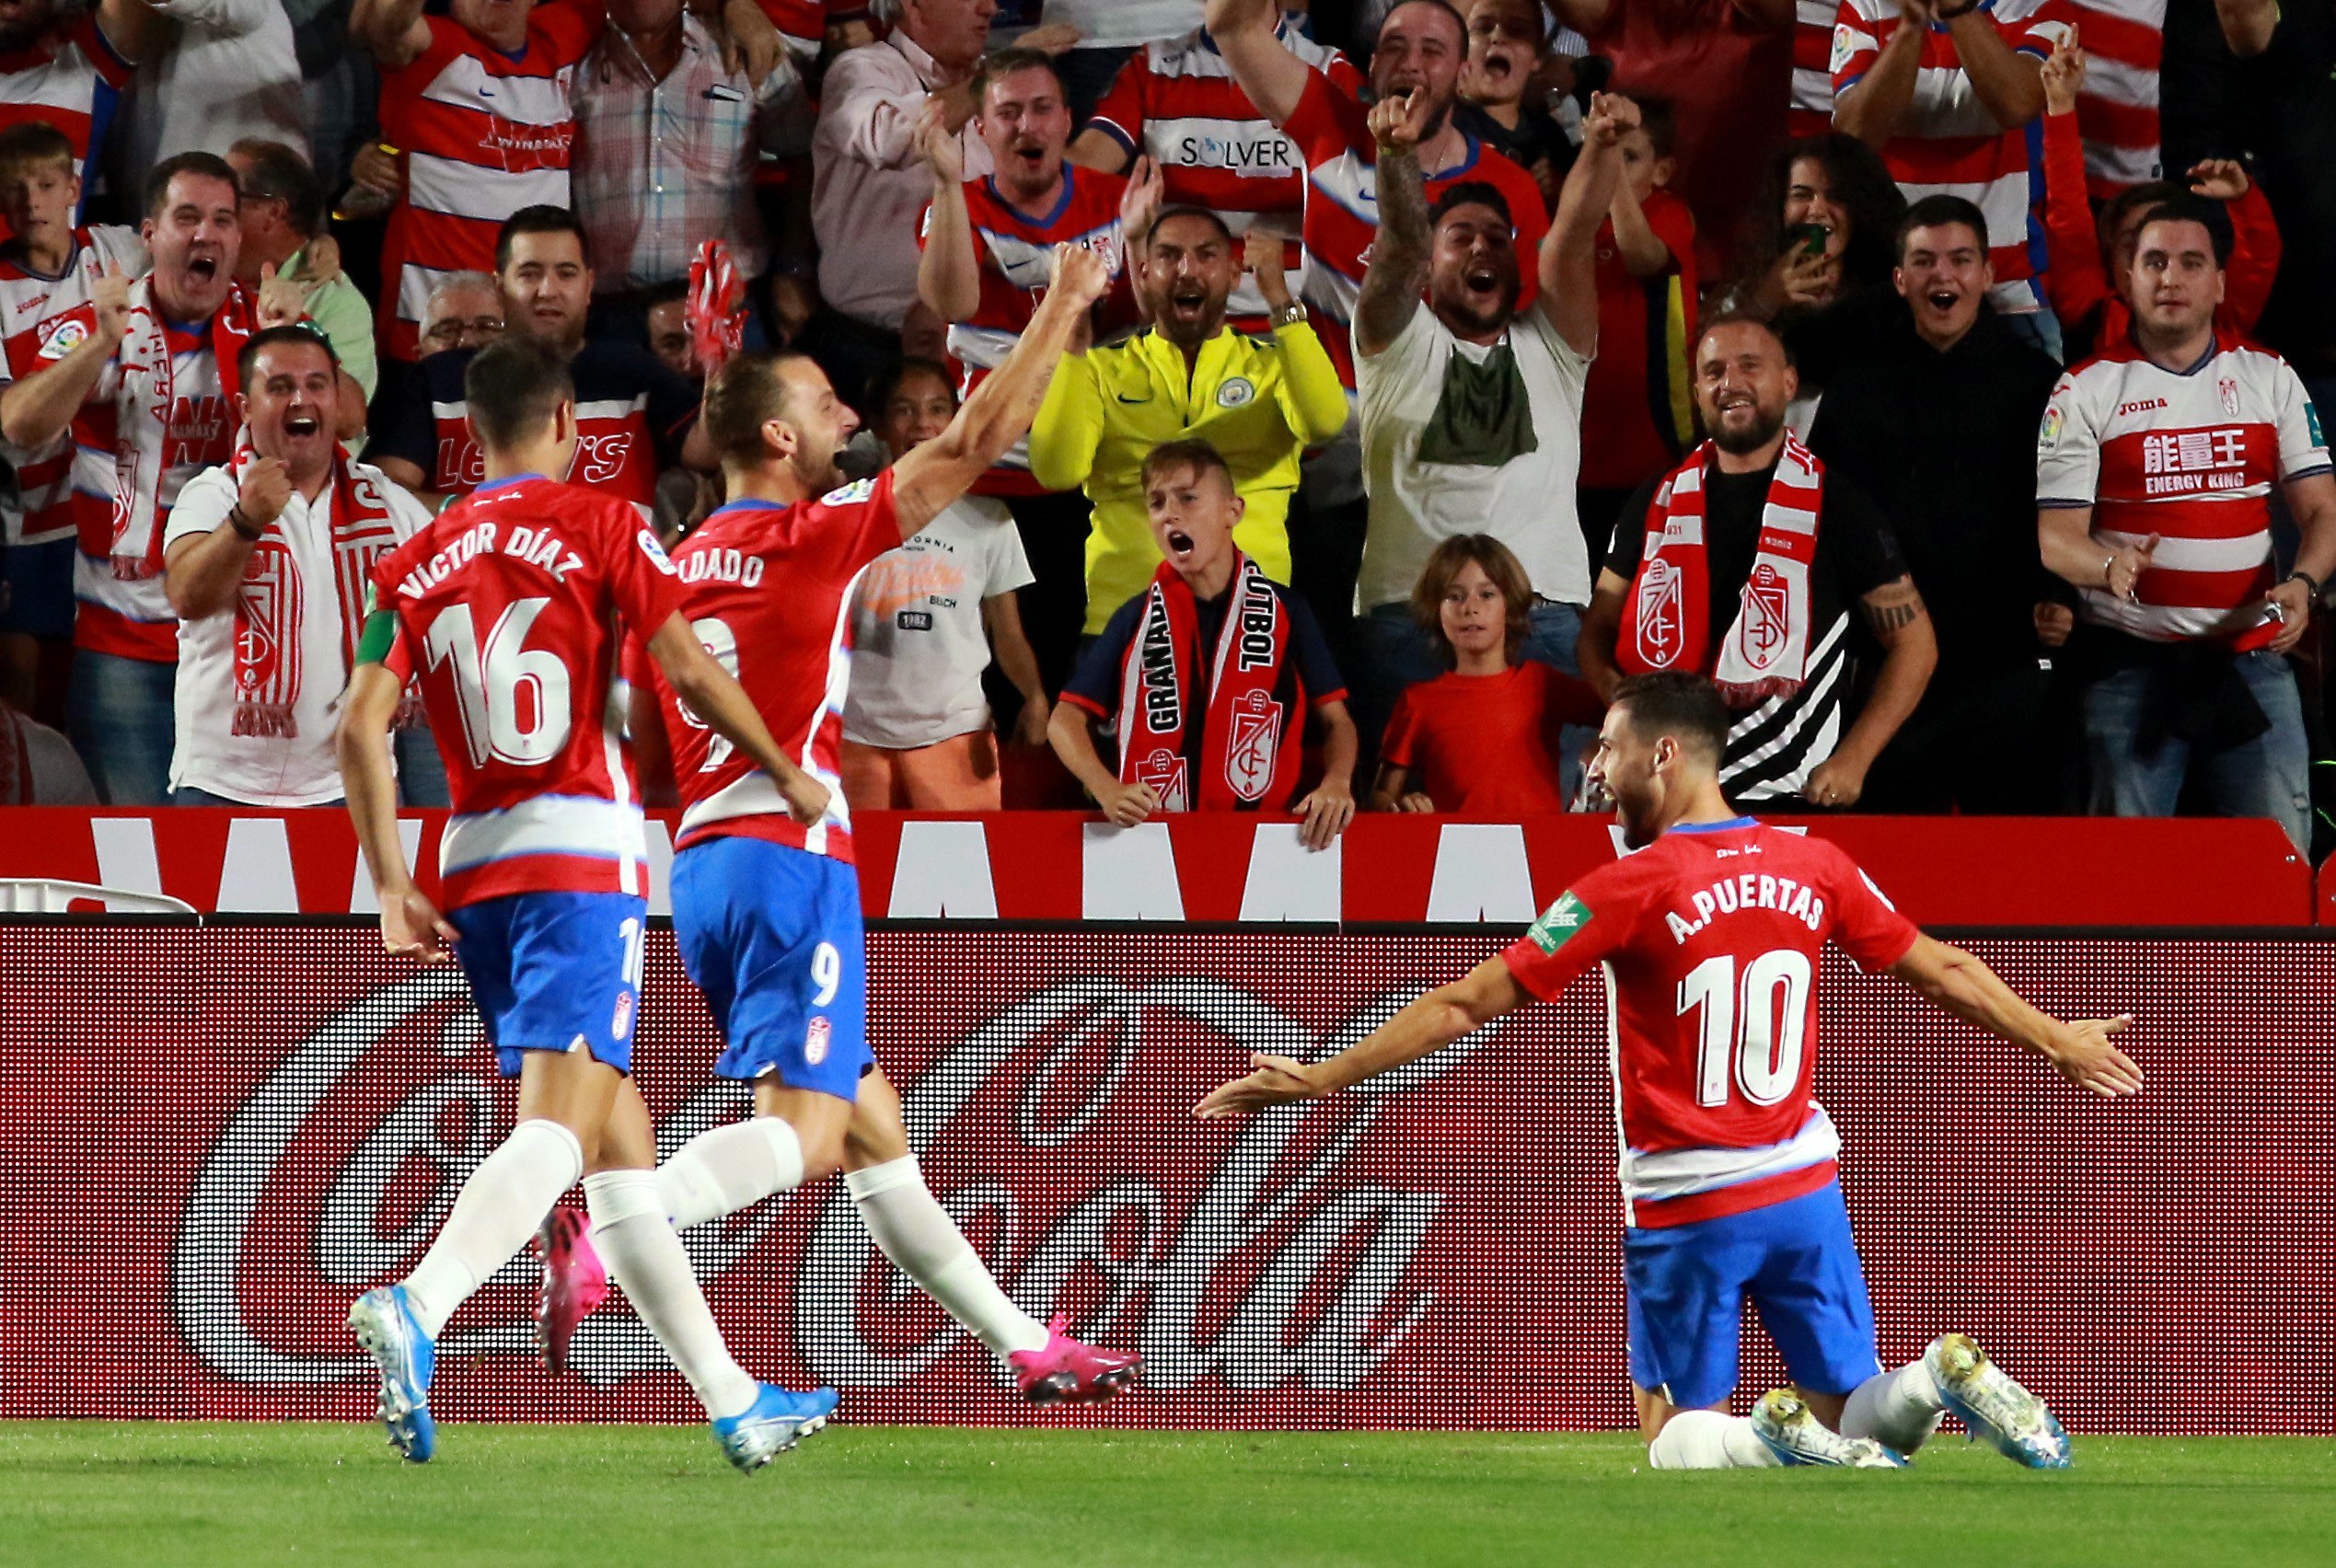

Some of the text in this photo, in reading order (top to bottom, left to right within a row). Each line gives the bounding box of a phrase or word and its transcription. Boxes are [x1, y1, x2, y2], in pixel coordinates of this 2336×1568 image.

[1181, 137, 1289, 167] SOLVER
[2143, 429, 2247, 474] 能量王
[2145, 472, 2245, 494] ENERGY KING
[503, 525, 584, 583] DÍAZ
[422, 597, 572, 769] 16
[1664, 874, 1824, 945] A.PUERTAS
[811, 941, 840, 1008] 9
[1676, 949, 1812, 1108] 10
